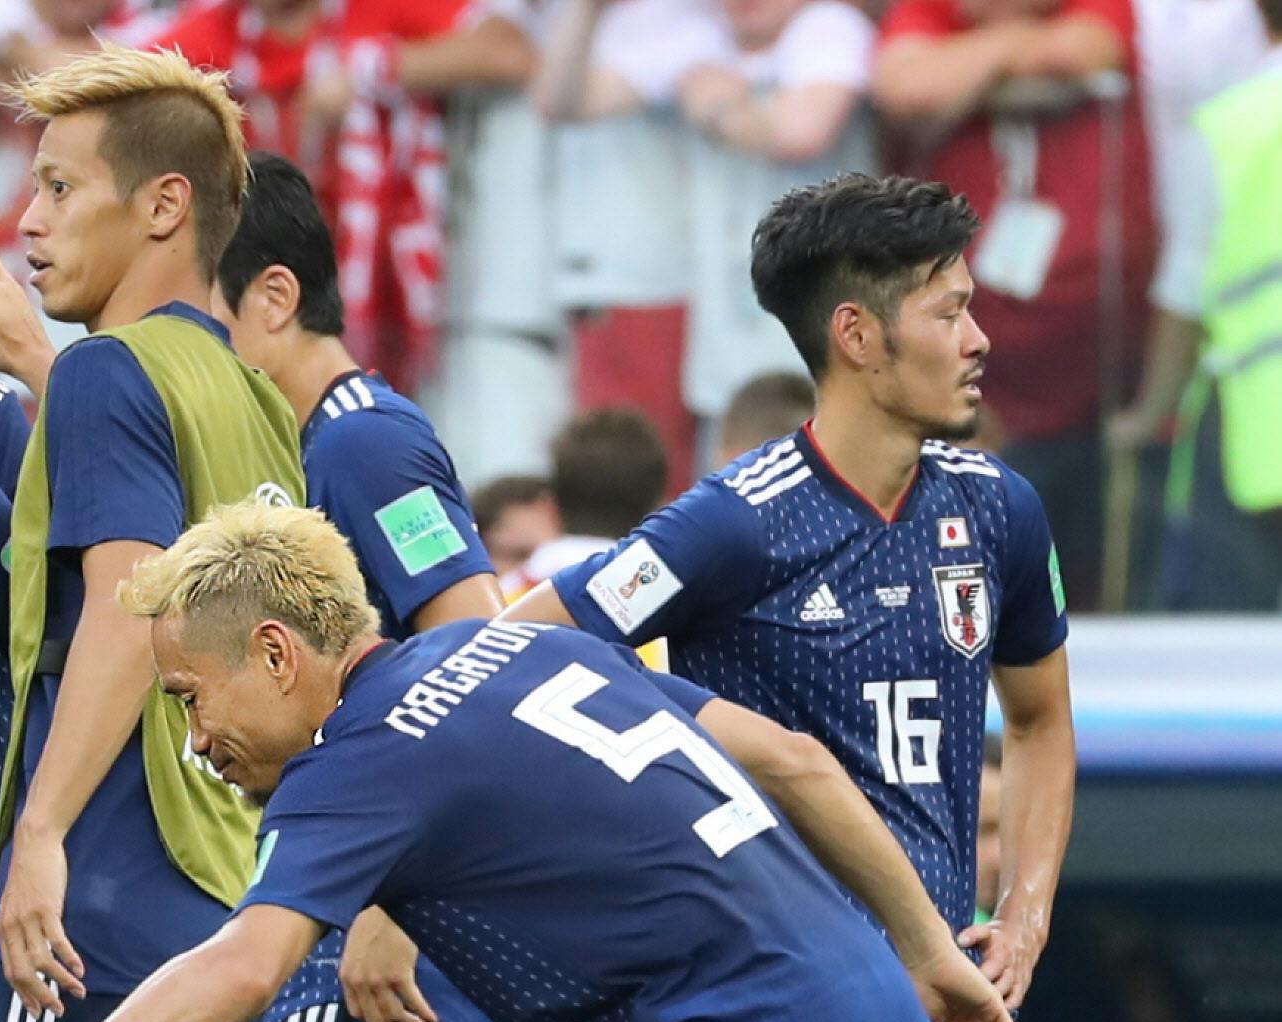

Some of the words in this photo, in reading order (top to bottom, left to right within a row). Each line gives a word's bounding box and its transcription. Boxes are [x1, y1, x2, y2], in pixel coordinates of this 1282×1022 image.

[800, 606, 846, 622] adidas
[511, 660, 780, 859] 5
[862, 679, 943, 784] 16
